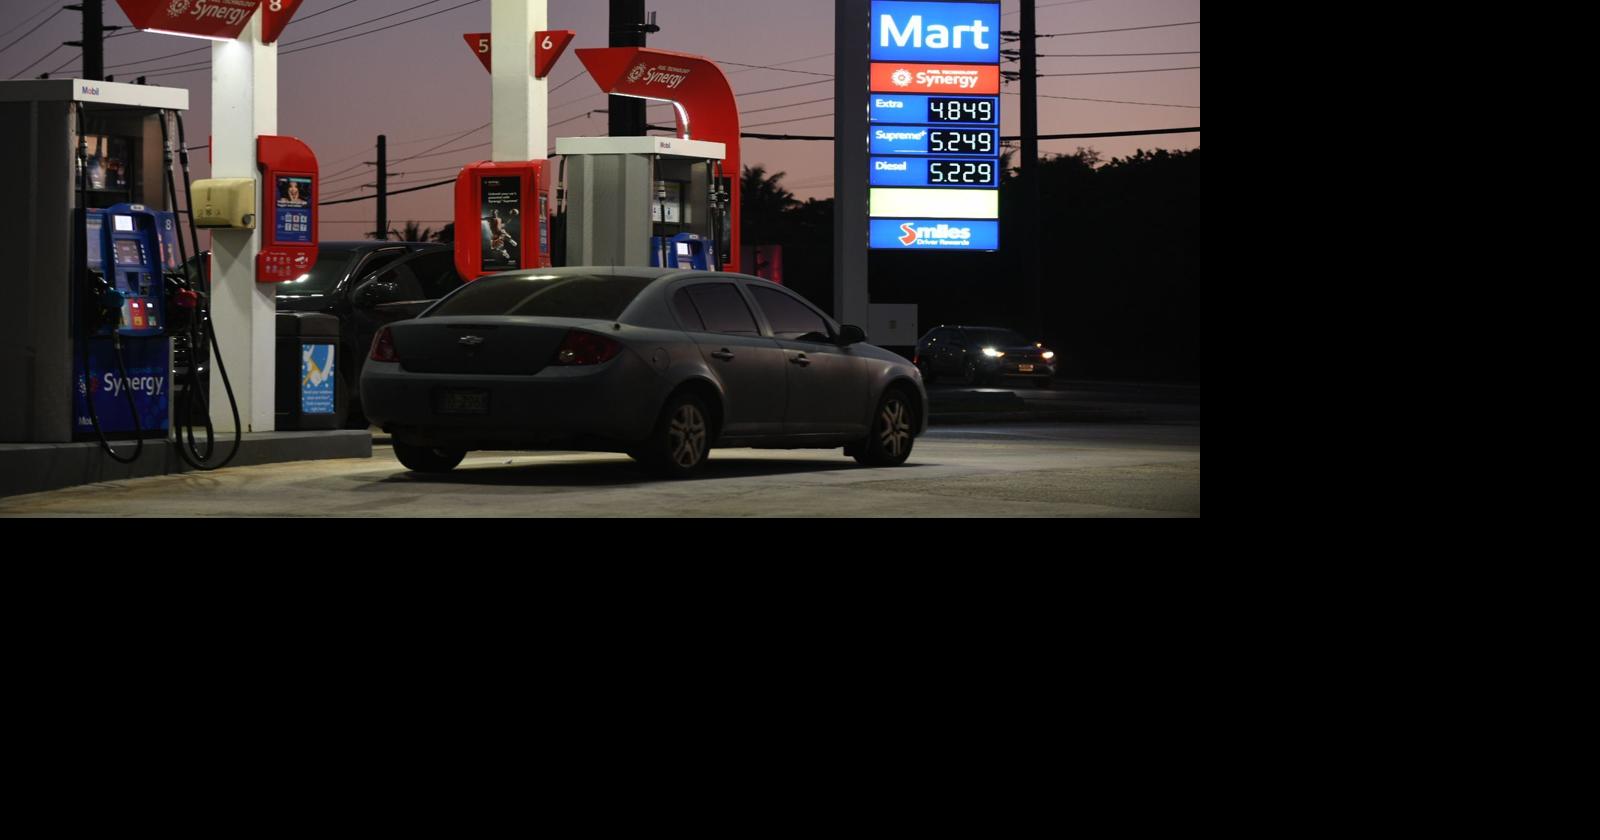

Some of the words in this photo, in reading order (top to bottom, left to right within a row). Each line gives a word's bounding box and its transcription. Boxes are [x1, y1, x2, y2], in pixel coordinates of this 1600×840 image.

[190, 1, 250, 26] Synergy
[269, 0, 282, 12] 8
[880, 14, 989, 49] Mart
[478, 38, 489, 53] 5
[541, 35, 553, 50] 6
[642, 67, 686, 89] Synergy
[915, 72, 979, 89] Synergy
[82, 86, 99, 96] Mobil
[875, 99, 903, 109] Extra
[930, 101, 991, 120] 4.849
[930, 132, 991, 151] 5.249
[875, 160, 907, 171] Diesel
[930, 163, 991, 182] 5.229
[165, 219, 172, 231] 8
[898, 222, 971, 246] Smiles
[103, 371, 164, 397] Synergy
